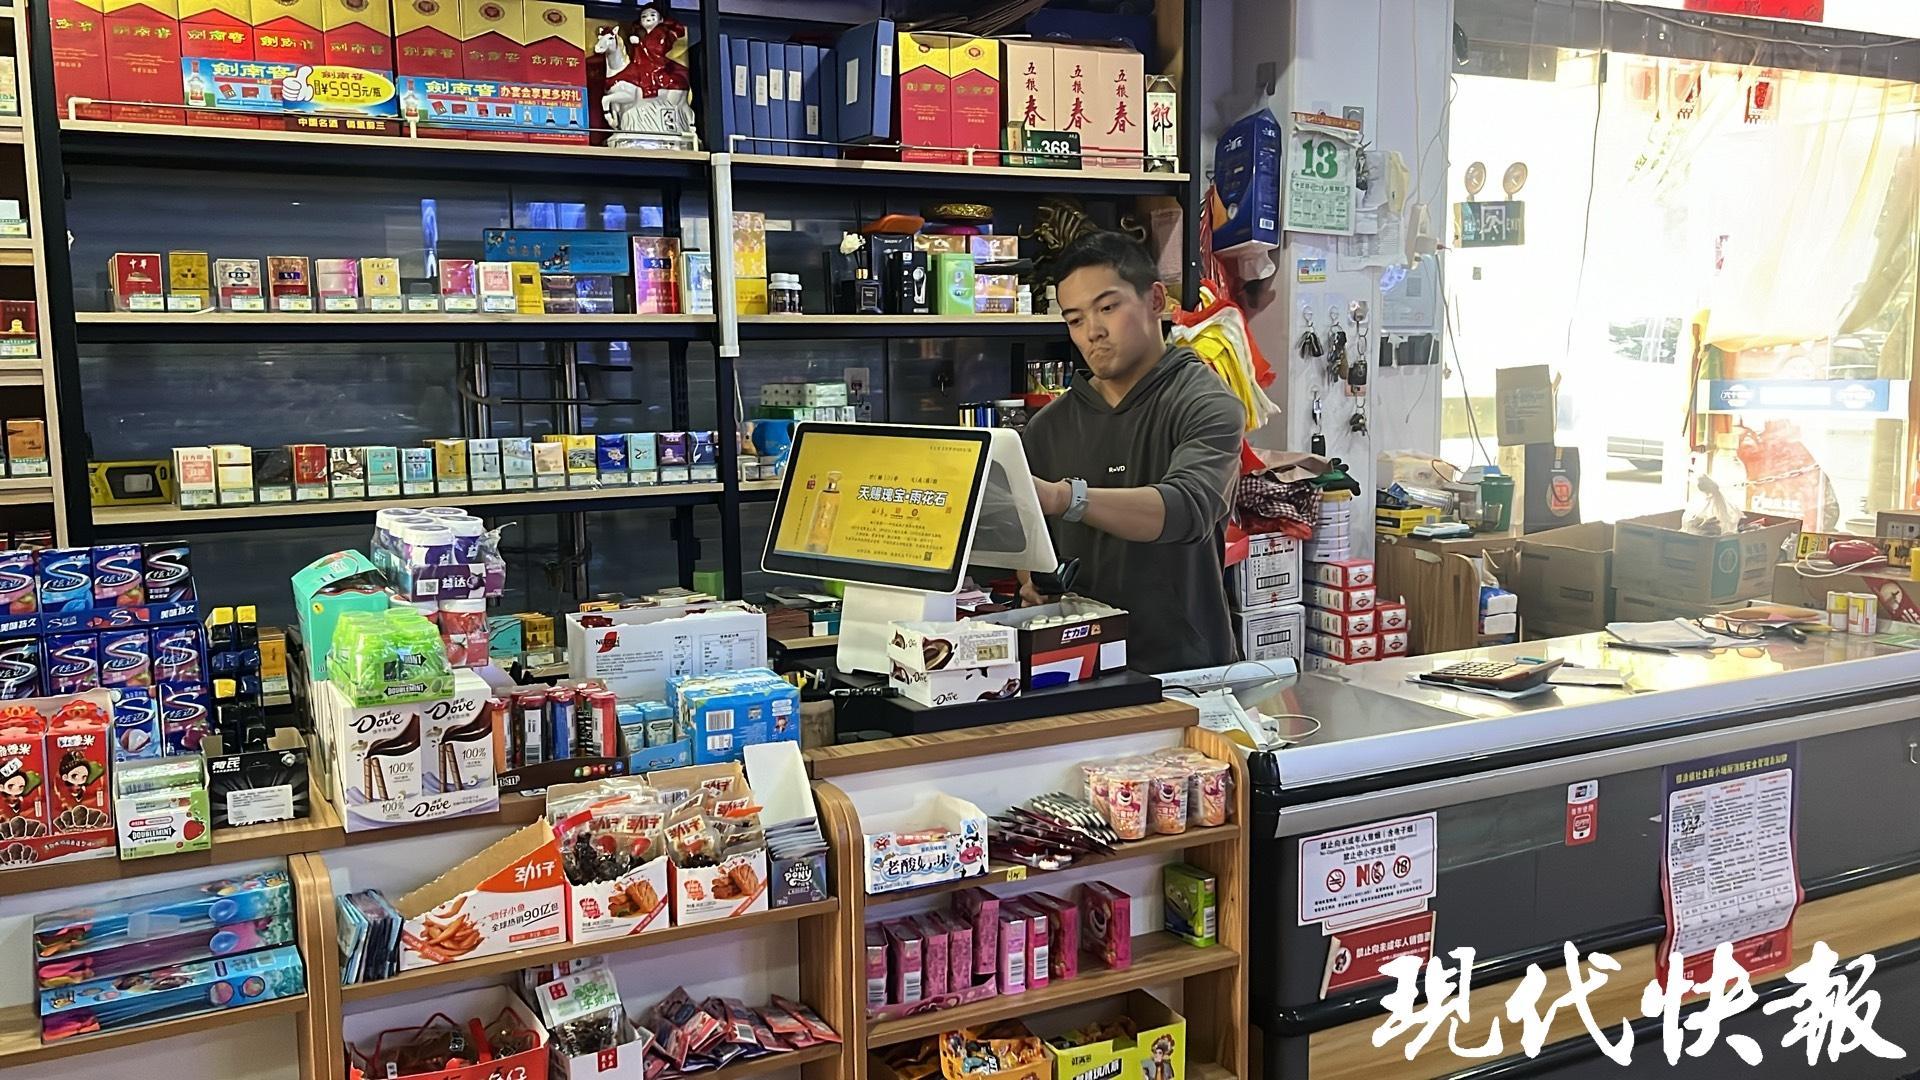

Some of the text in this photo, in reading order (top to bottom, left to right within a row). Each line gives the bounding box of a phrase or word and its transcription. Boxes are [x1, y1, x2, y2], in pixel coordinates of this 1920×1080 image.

[500, 86, 582, 102] 办宴会享更多好礼
[1062, 65, 1093, 132] 五粮春
[1106, 69, 1137, 135] 五粮春
[1040, 139, 1070, 159] 368
[1301, 138, 1339, 179] 13
[441, 576, 467, 589] 益达
[424, 699, 476, 721] Dove
[349, 712, 403, 734] Dove
[461, 747, 487, 760] 100%
[388, 762, 415, 775] 100%
[381, 801, 405, 813] 100%
[408, 800, 451, 818] Dove
[132, 827, 173, 841] DOUBLEMINT
[514, 859, 557, 889] 劲仔
[1396, 859, 1408, 874] 18
